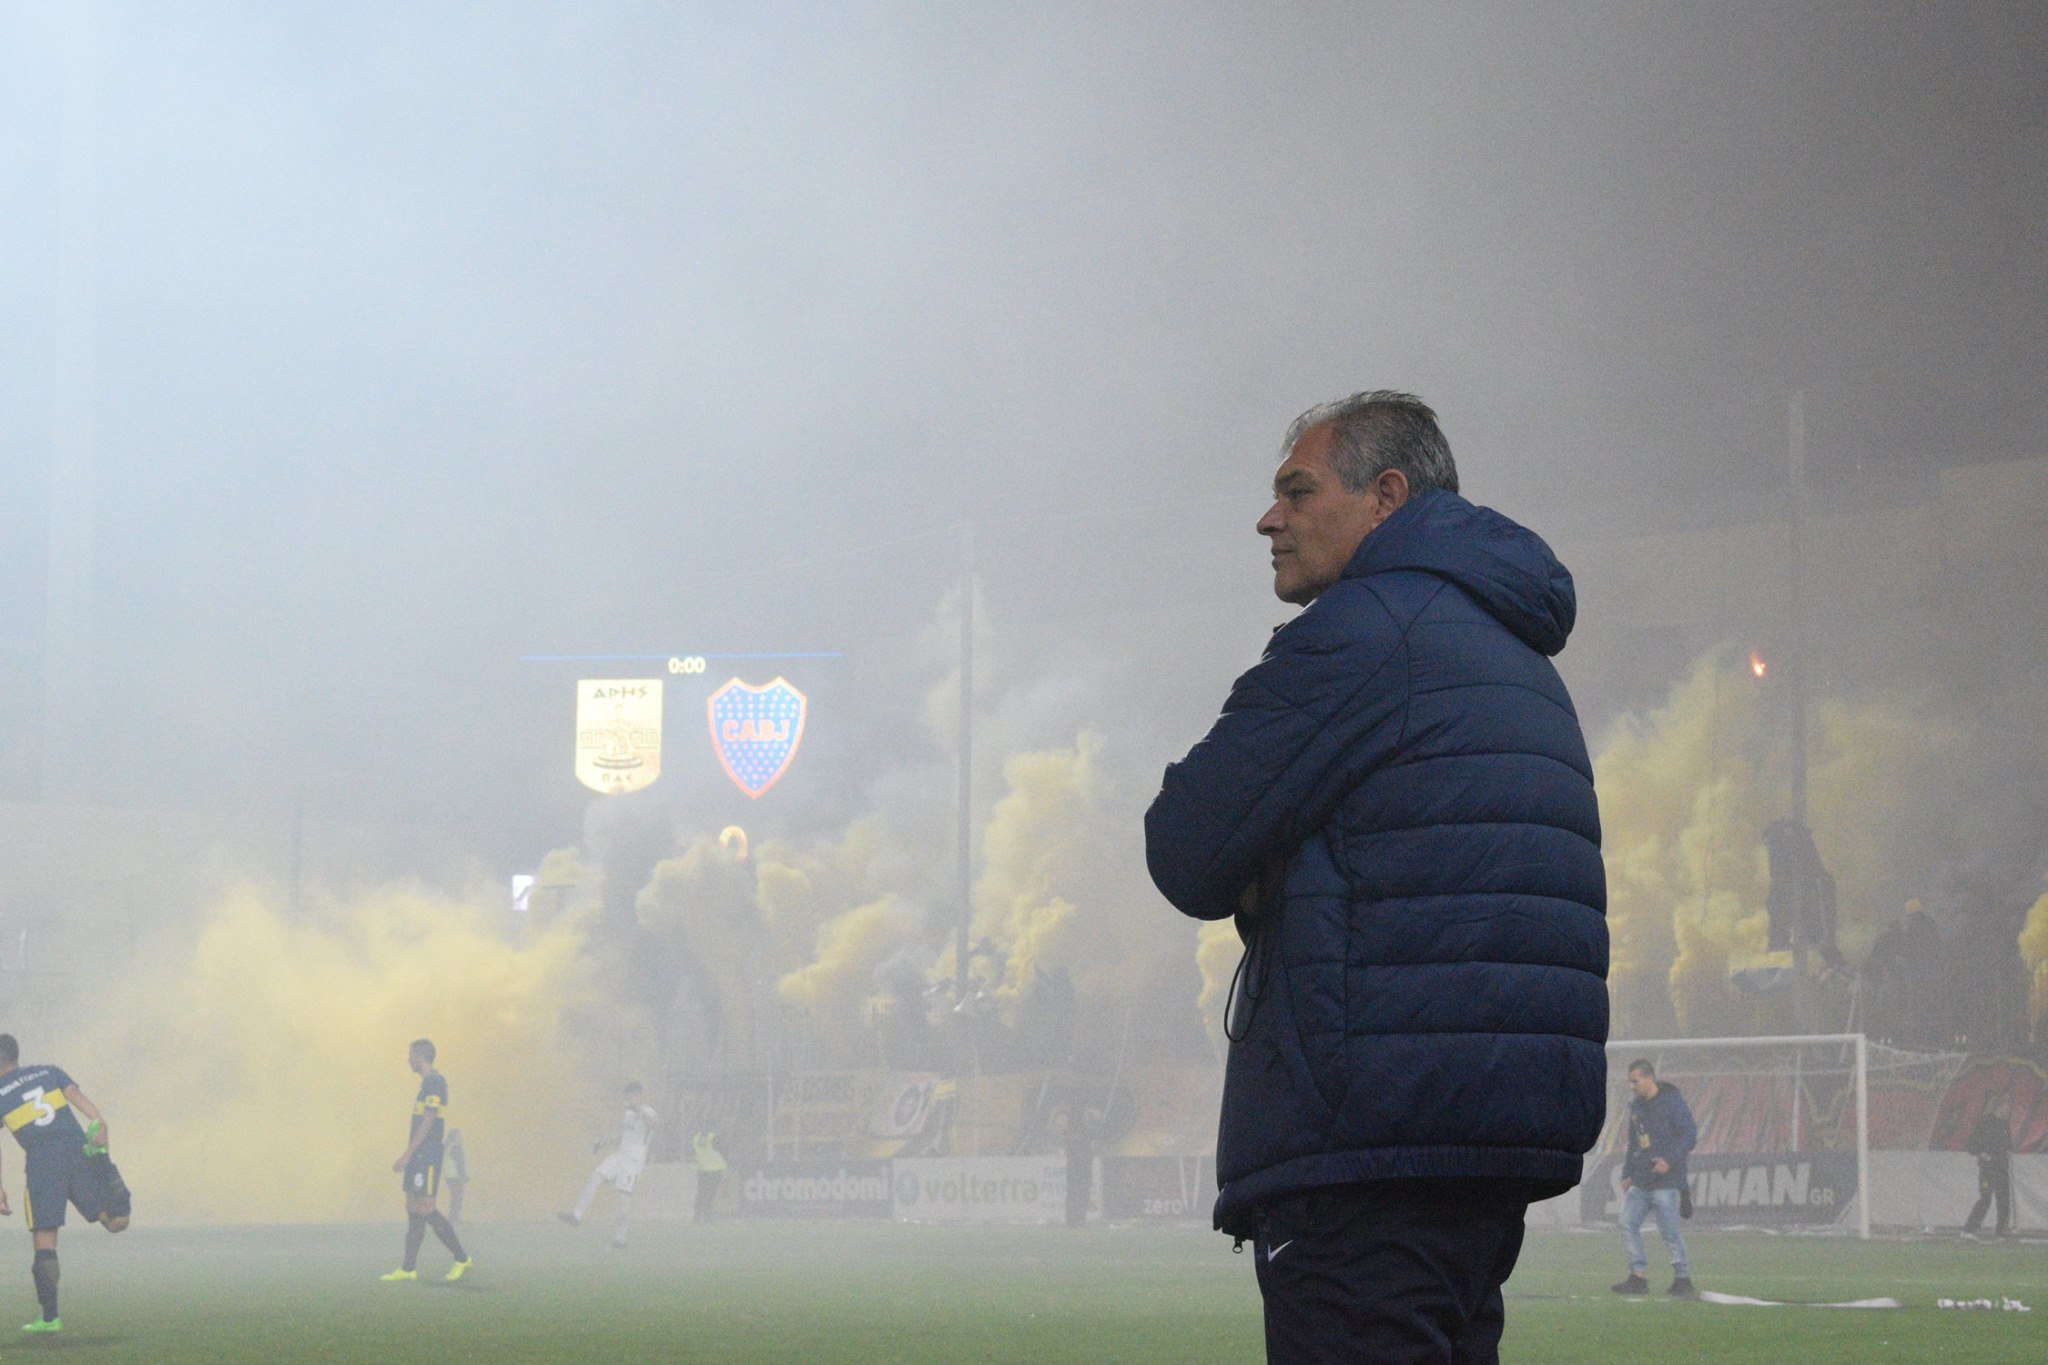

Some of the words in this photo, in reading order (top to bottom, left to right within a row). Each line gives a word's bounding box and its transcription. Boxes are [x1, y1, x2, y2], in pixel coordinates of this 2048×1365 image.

[667, 657, 706, 674] 0:00
[722, 719, 789, 741] CABJ
[21, 1086, 56, 1126] 3
[414, 1172, 424, 1187] 6
[925, 1172, 1038, 1203] volterra
[1810, 1188, 1835, 1205] GR
[1143, 1198, 1182, 1215] zero
